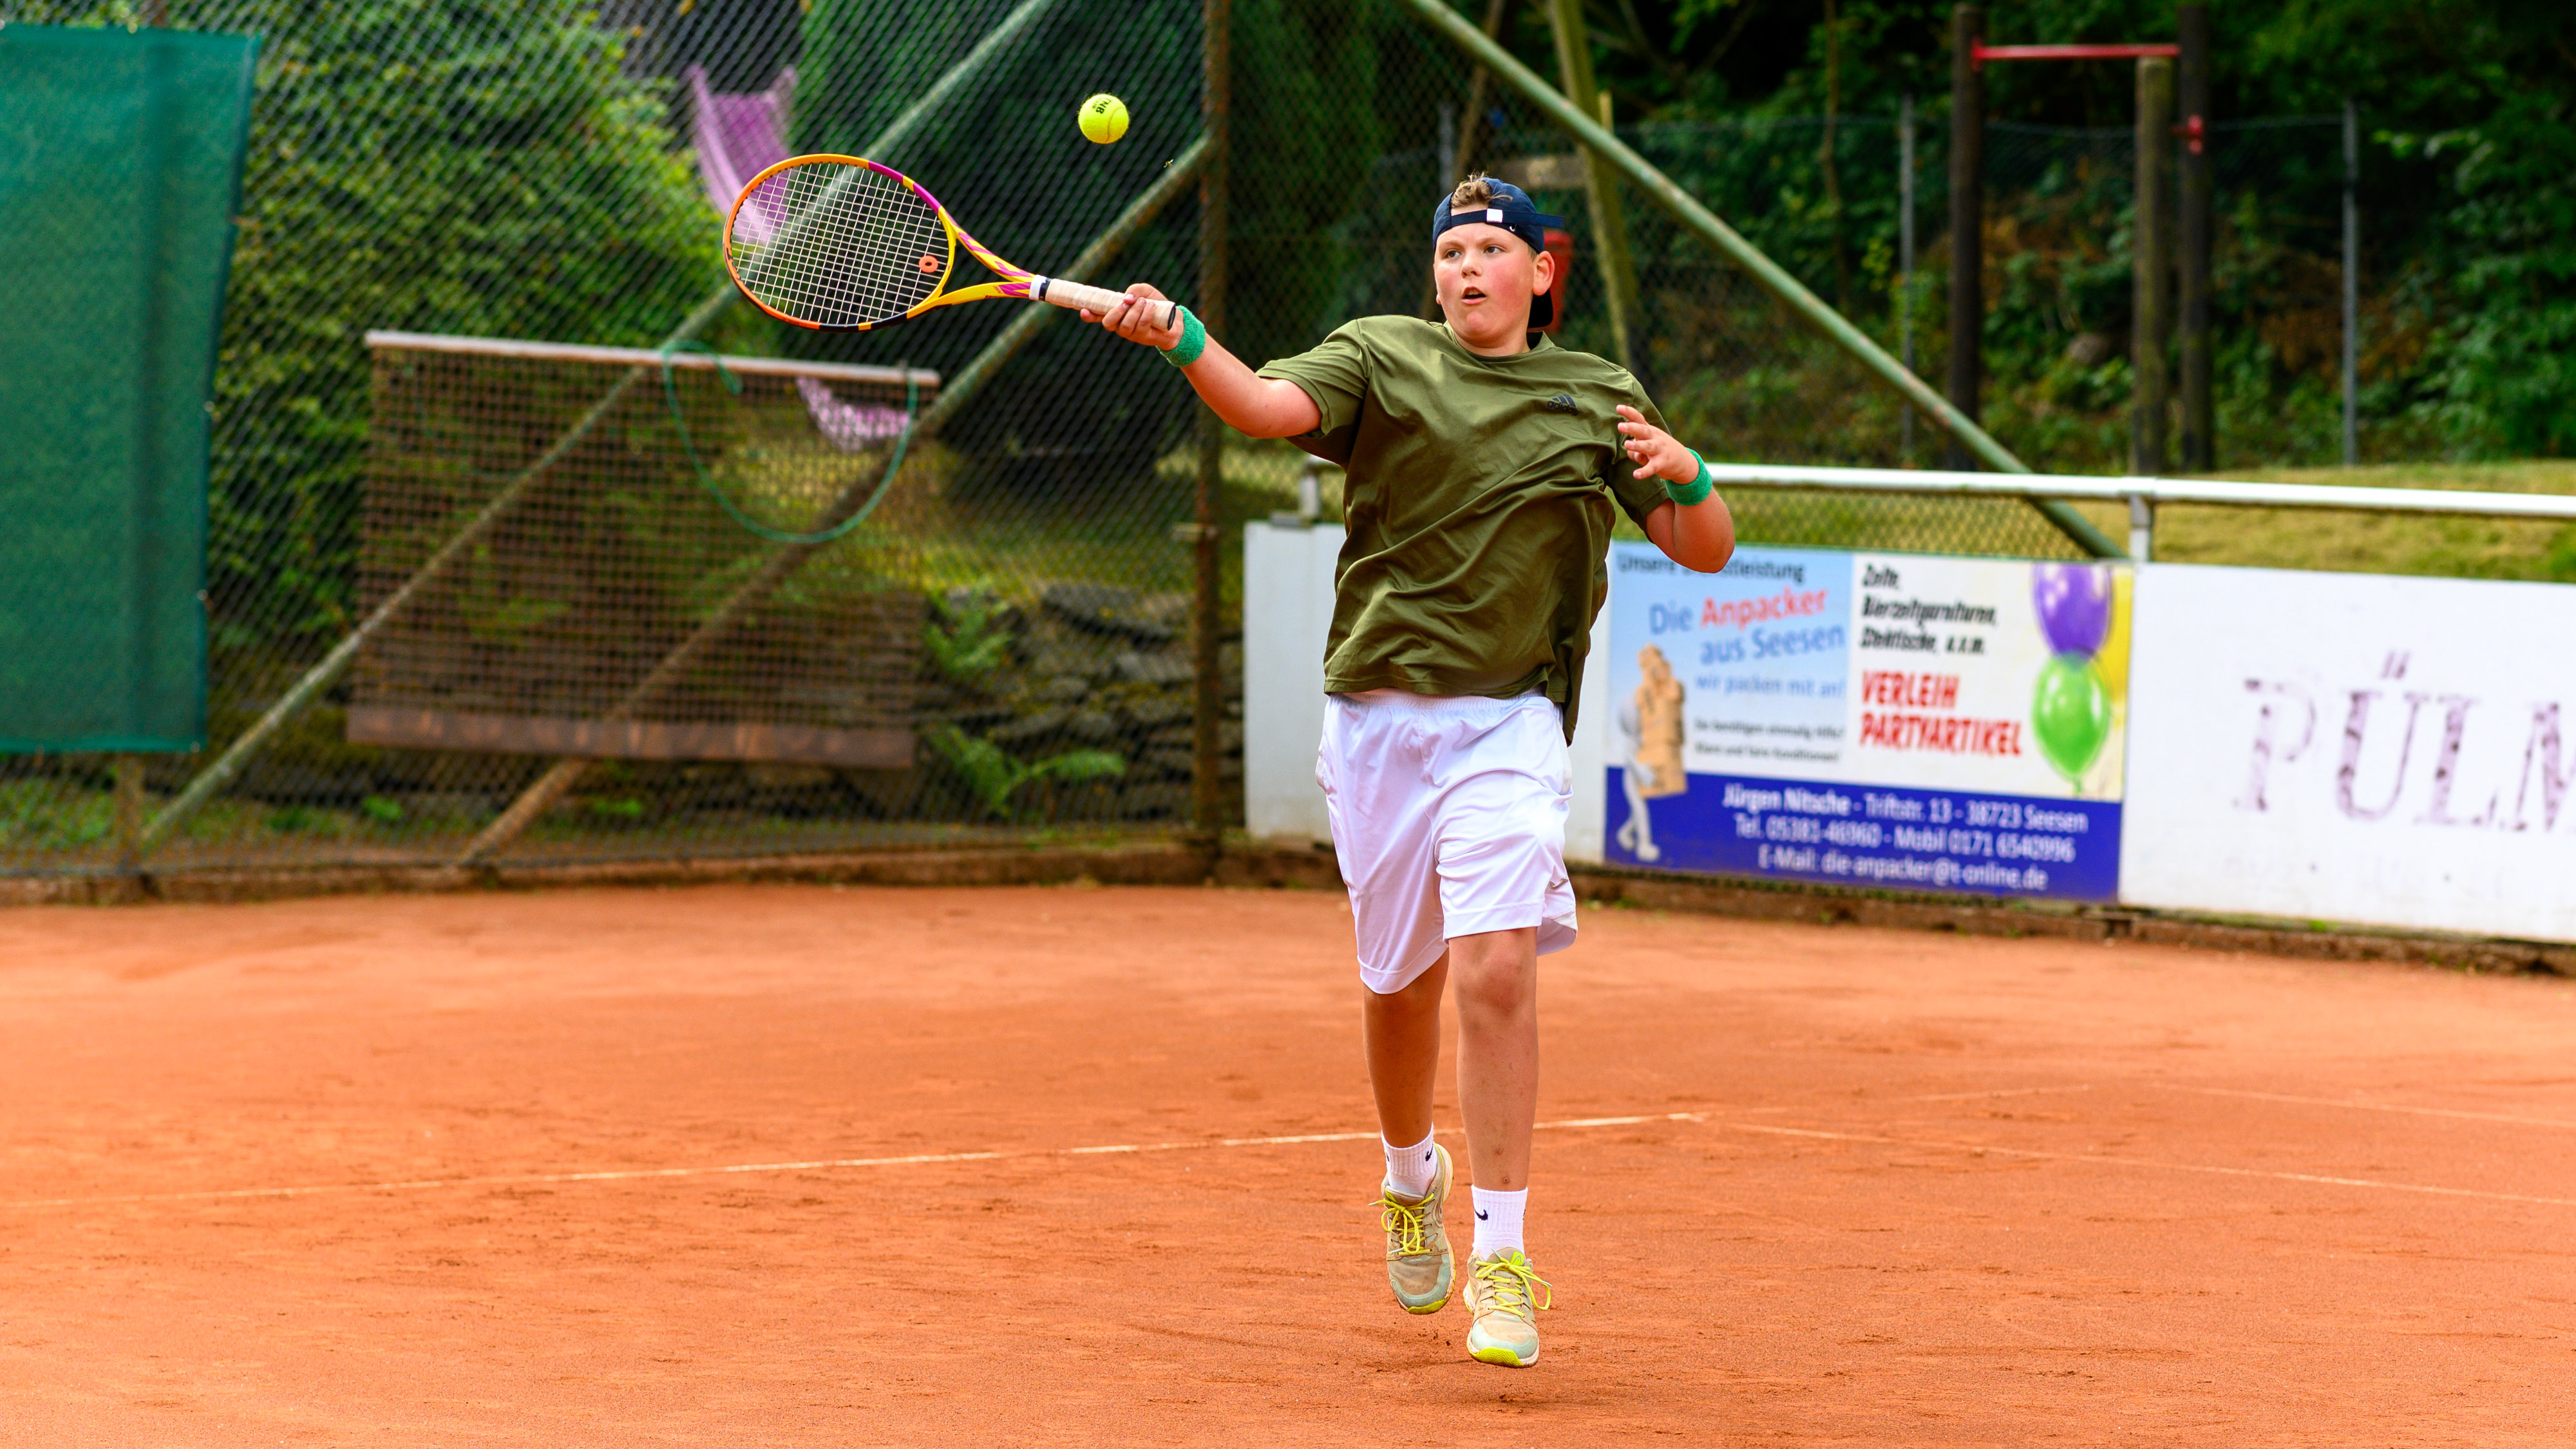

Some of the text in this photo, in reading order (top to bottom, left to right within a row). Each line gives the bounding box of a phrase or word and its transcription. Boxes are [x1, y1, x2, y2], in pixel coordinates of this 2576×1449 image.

[1548, 401, 1579, 416] adidas
[1649, 587, 1828, 636] Die Anpacker
[1700, 625, 1846, 665] aus Seesen
[1696, 674, 1721, 690] wir
[1725, 674, 1780, 694] packen
[1786, 679, 1815, 696] mit
[1862, 670, 1962, 710] VERLEIH
[1859, 710, 2023, 757] PARTYARTIKEL
[1722, 782, 1782, 814] Jürgen
[1783, 786, 1852, 817] Nitsche
[1927, 797, 1953, 824] 13
[1965, 799, 2023, 829] 38723
[2023, 803, 2089, 834] Seesen
[1734, 812, 1766, 839] Tel.
[1893, 824, 1947, 853] Mobil
[1948, 828, 1994, 857] 0171
